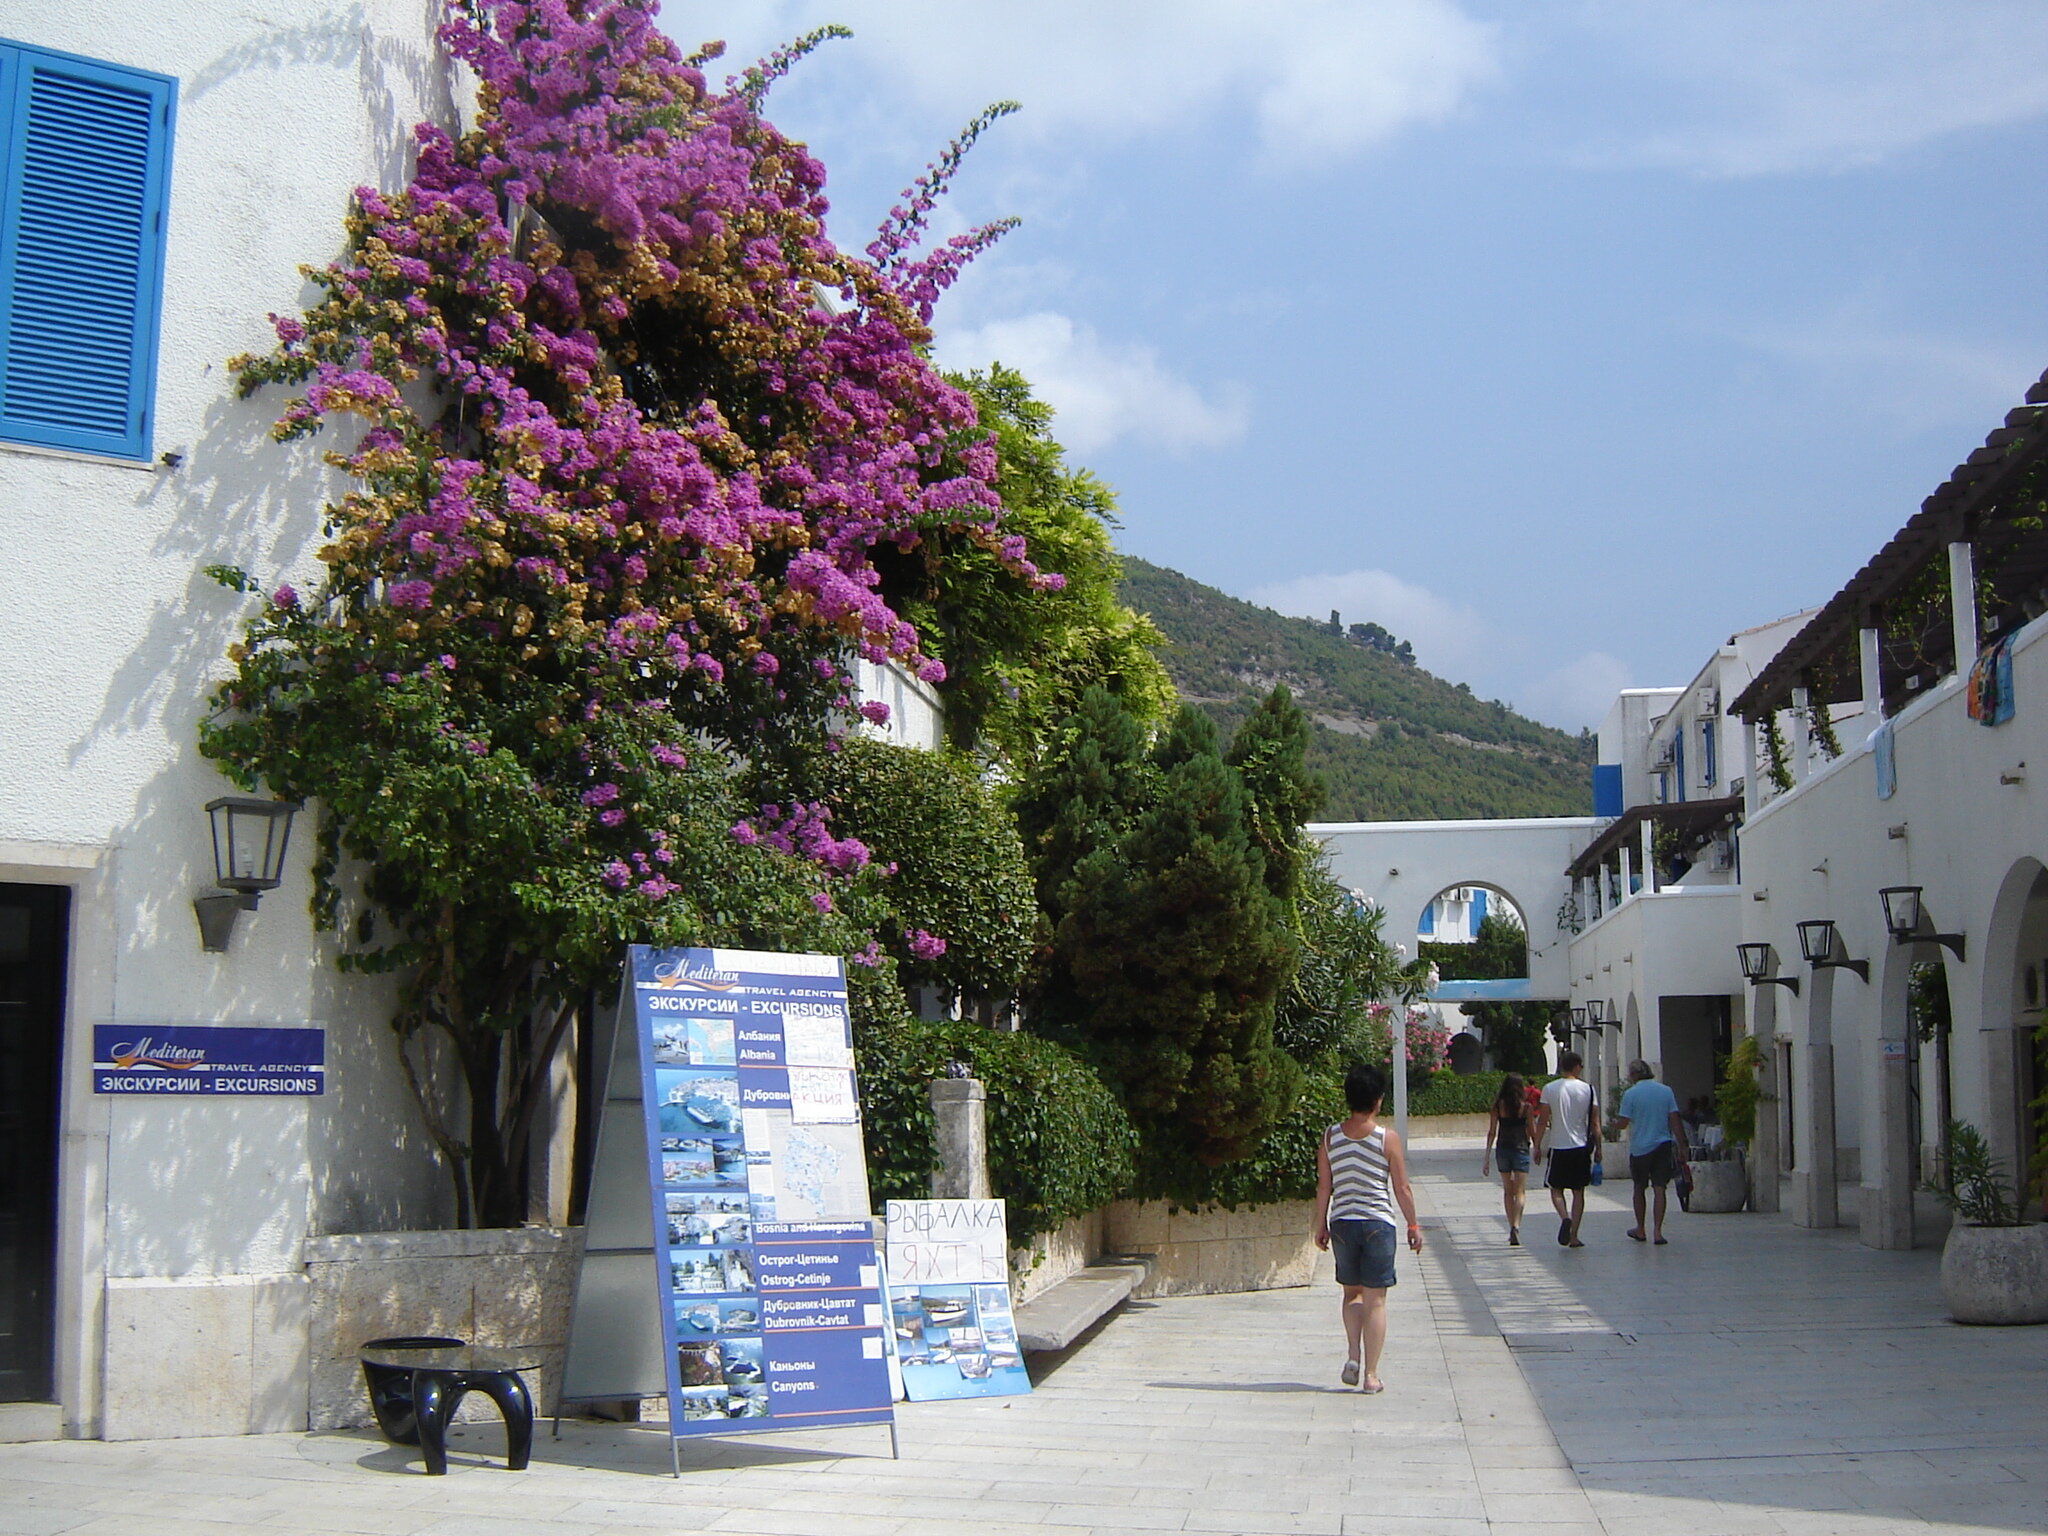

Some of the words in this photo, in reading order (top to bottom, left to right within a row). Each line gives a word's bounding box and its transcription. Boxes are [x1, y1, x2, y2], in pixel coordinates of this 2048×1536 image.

[654, 958, 740, 982] Mediteran
[745, 986, 786, 996] TRAVEL
[789, 988, 834, 998] AGENCY
[649, 996, 739, 1013] ЭКСКУРСИИ
[751, 1001, 843, 1018] EXCURSIONS
[738, 1030, 781, 1042] Албания
[110, 1037, 206, 1059] Mediteran
[739, 1049, 776, 1060] Albania
[210, 1064, 256, 1072] TRAVEL
[259, 1064, 310, 1072] AGENCY
[102, 1077, 201, 1091] ЭКСКУРСИИ
[215, 1078, 317, 1092] EXCURSIONS
[743, 1089, 792, 1103] Дубровни
[888, 1202, 1004, 1233] РЫБАЛКА
[756, 1222, 789, 1233] Bosnia
[759, 1253, 839, 1266] Острог-Цетинье
[902, 1243, 1005, 1280] ЯХТЫ
[761, 1273, 832, 1287] Ostrog-Cetinje
[763, 1298, 857, 1313] Дубровник-Цавтат
[765, 1315, 850, 1328] Dubrovnik-Cavtat
[769, 1360, 816, 1372] Каньоны
[772, 1380, 816, 1394] Canyons
